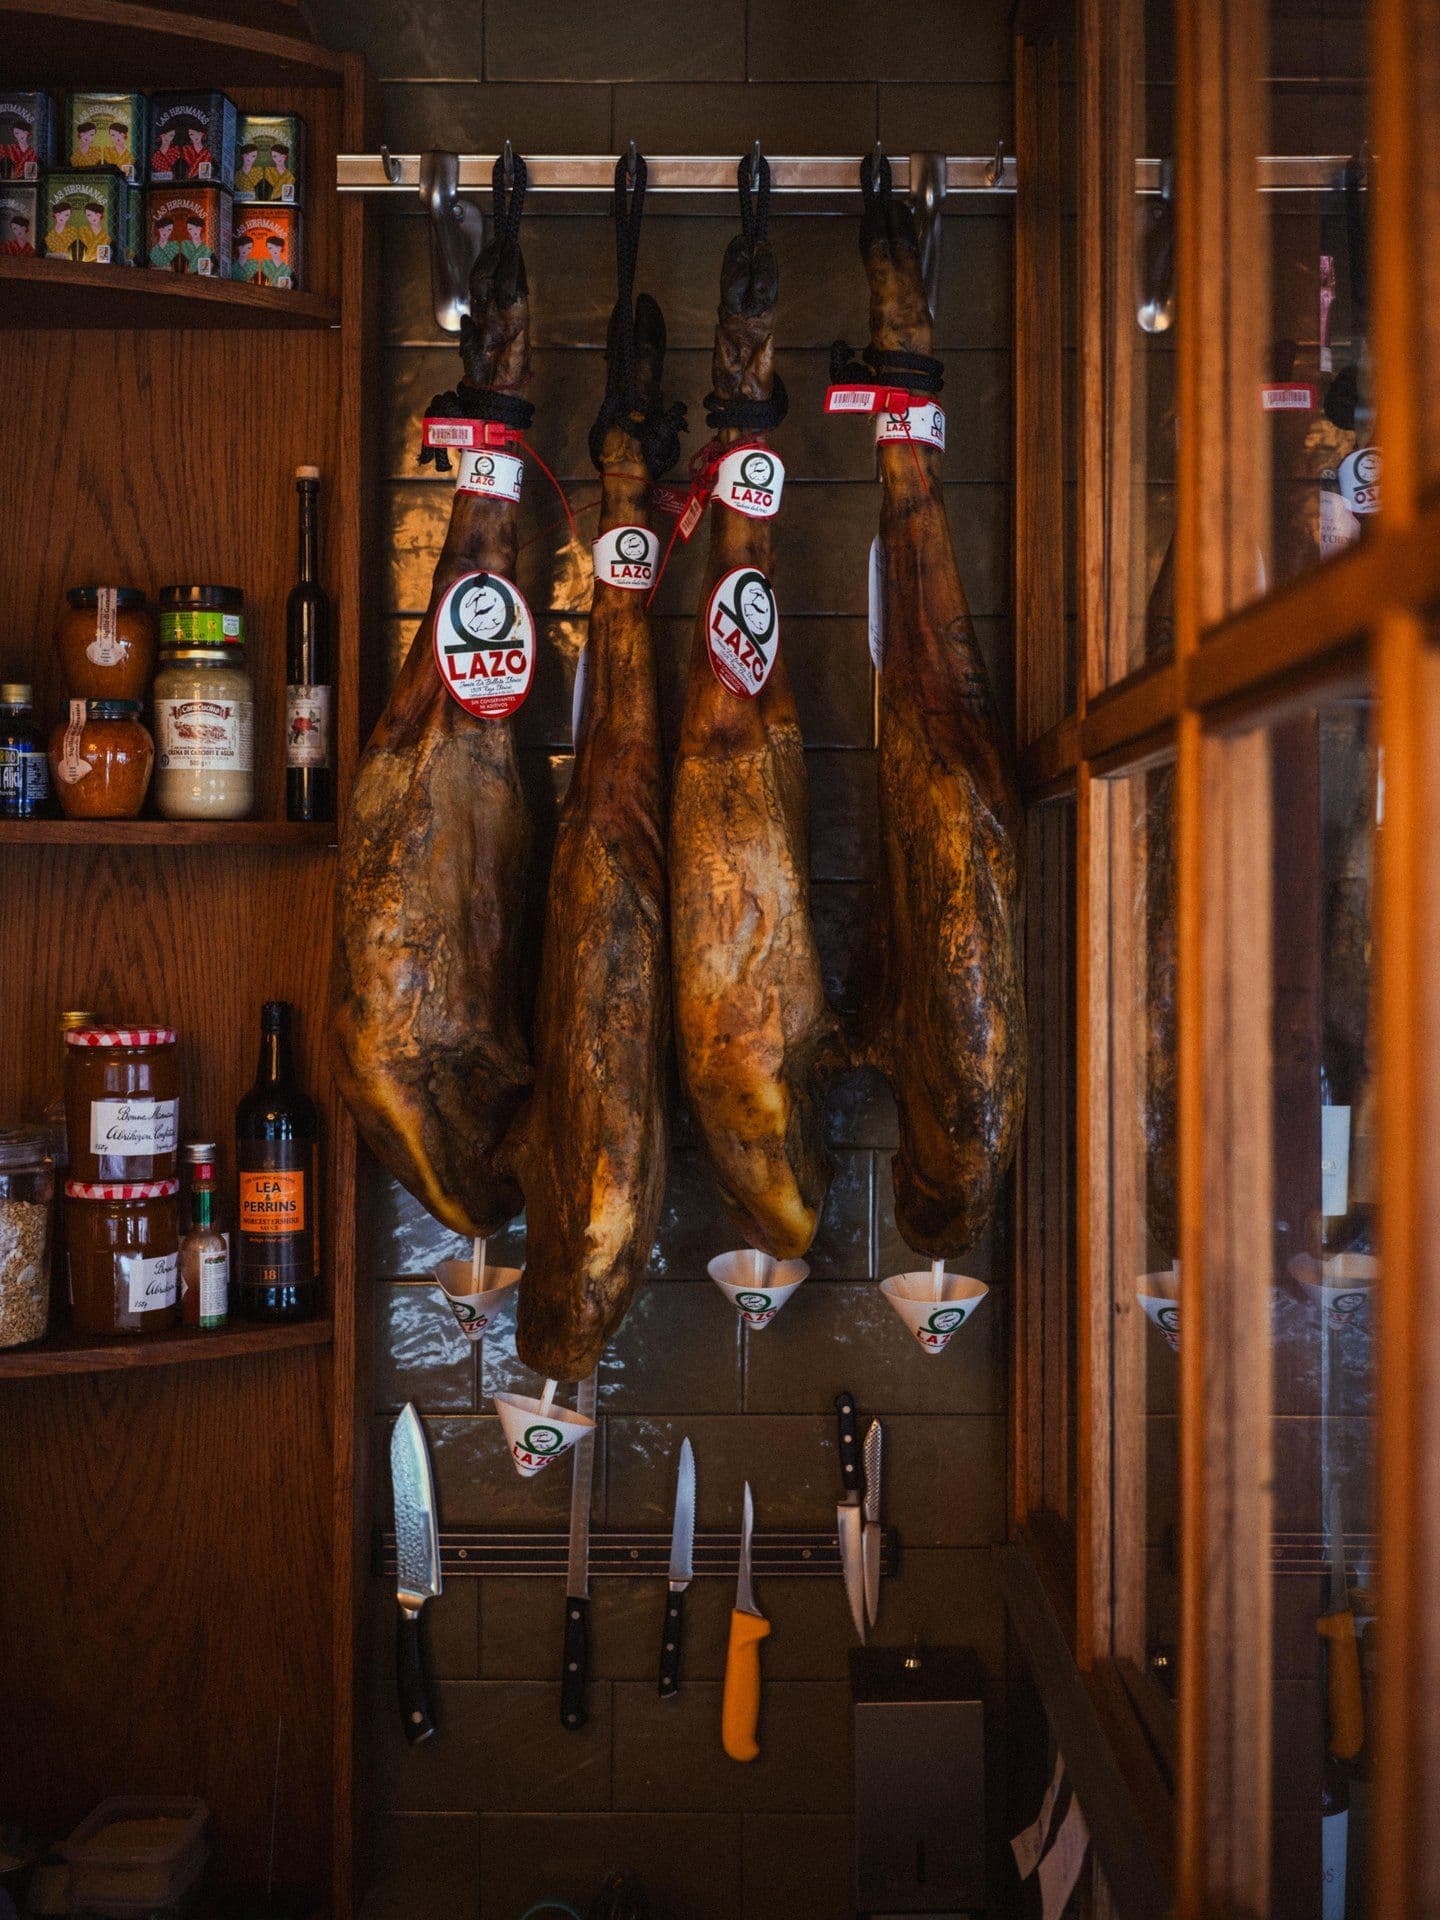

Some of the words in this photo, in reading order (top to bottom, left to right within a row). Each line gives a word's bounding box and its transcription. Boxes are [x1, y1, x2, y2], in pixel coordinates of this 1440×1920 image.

[0, 103, 35, 123] ERMANAS
[89, 104, 131, 124] HERMANAS
[155, 112, 170, 127] LAS
[170, 105, 210, 125] HERMANAS
[49, 190, 64, 206] LAS
[64, 183, 108, 205] HERMANAS
[153, 205, 168, 221] LAS
[168, 199, 208, 219] HERMANAS
[246, 218, 288, 238] HERMANAS
[886, 422, 911, 432] LAZO
[470, 475, 496, 486] LAZO
[513, 485, 521, 494] LA
[731, 487, 773, 507] LAZO
[611, 565, 652, 580] LAZO
[712, 609, 764, 682] LAZO
[447, 650, 527, 681] LAZO
[117, 1106, 147, 1121] Bonne
[256, 1182, 281, 1193] LEA
[244, 1201, 297, 1213] PERRINS
[463, 1318, 488, 1332] ZO
[916, 1330, 952, 1345] LAZ
